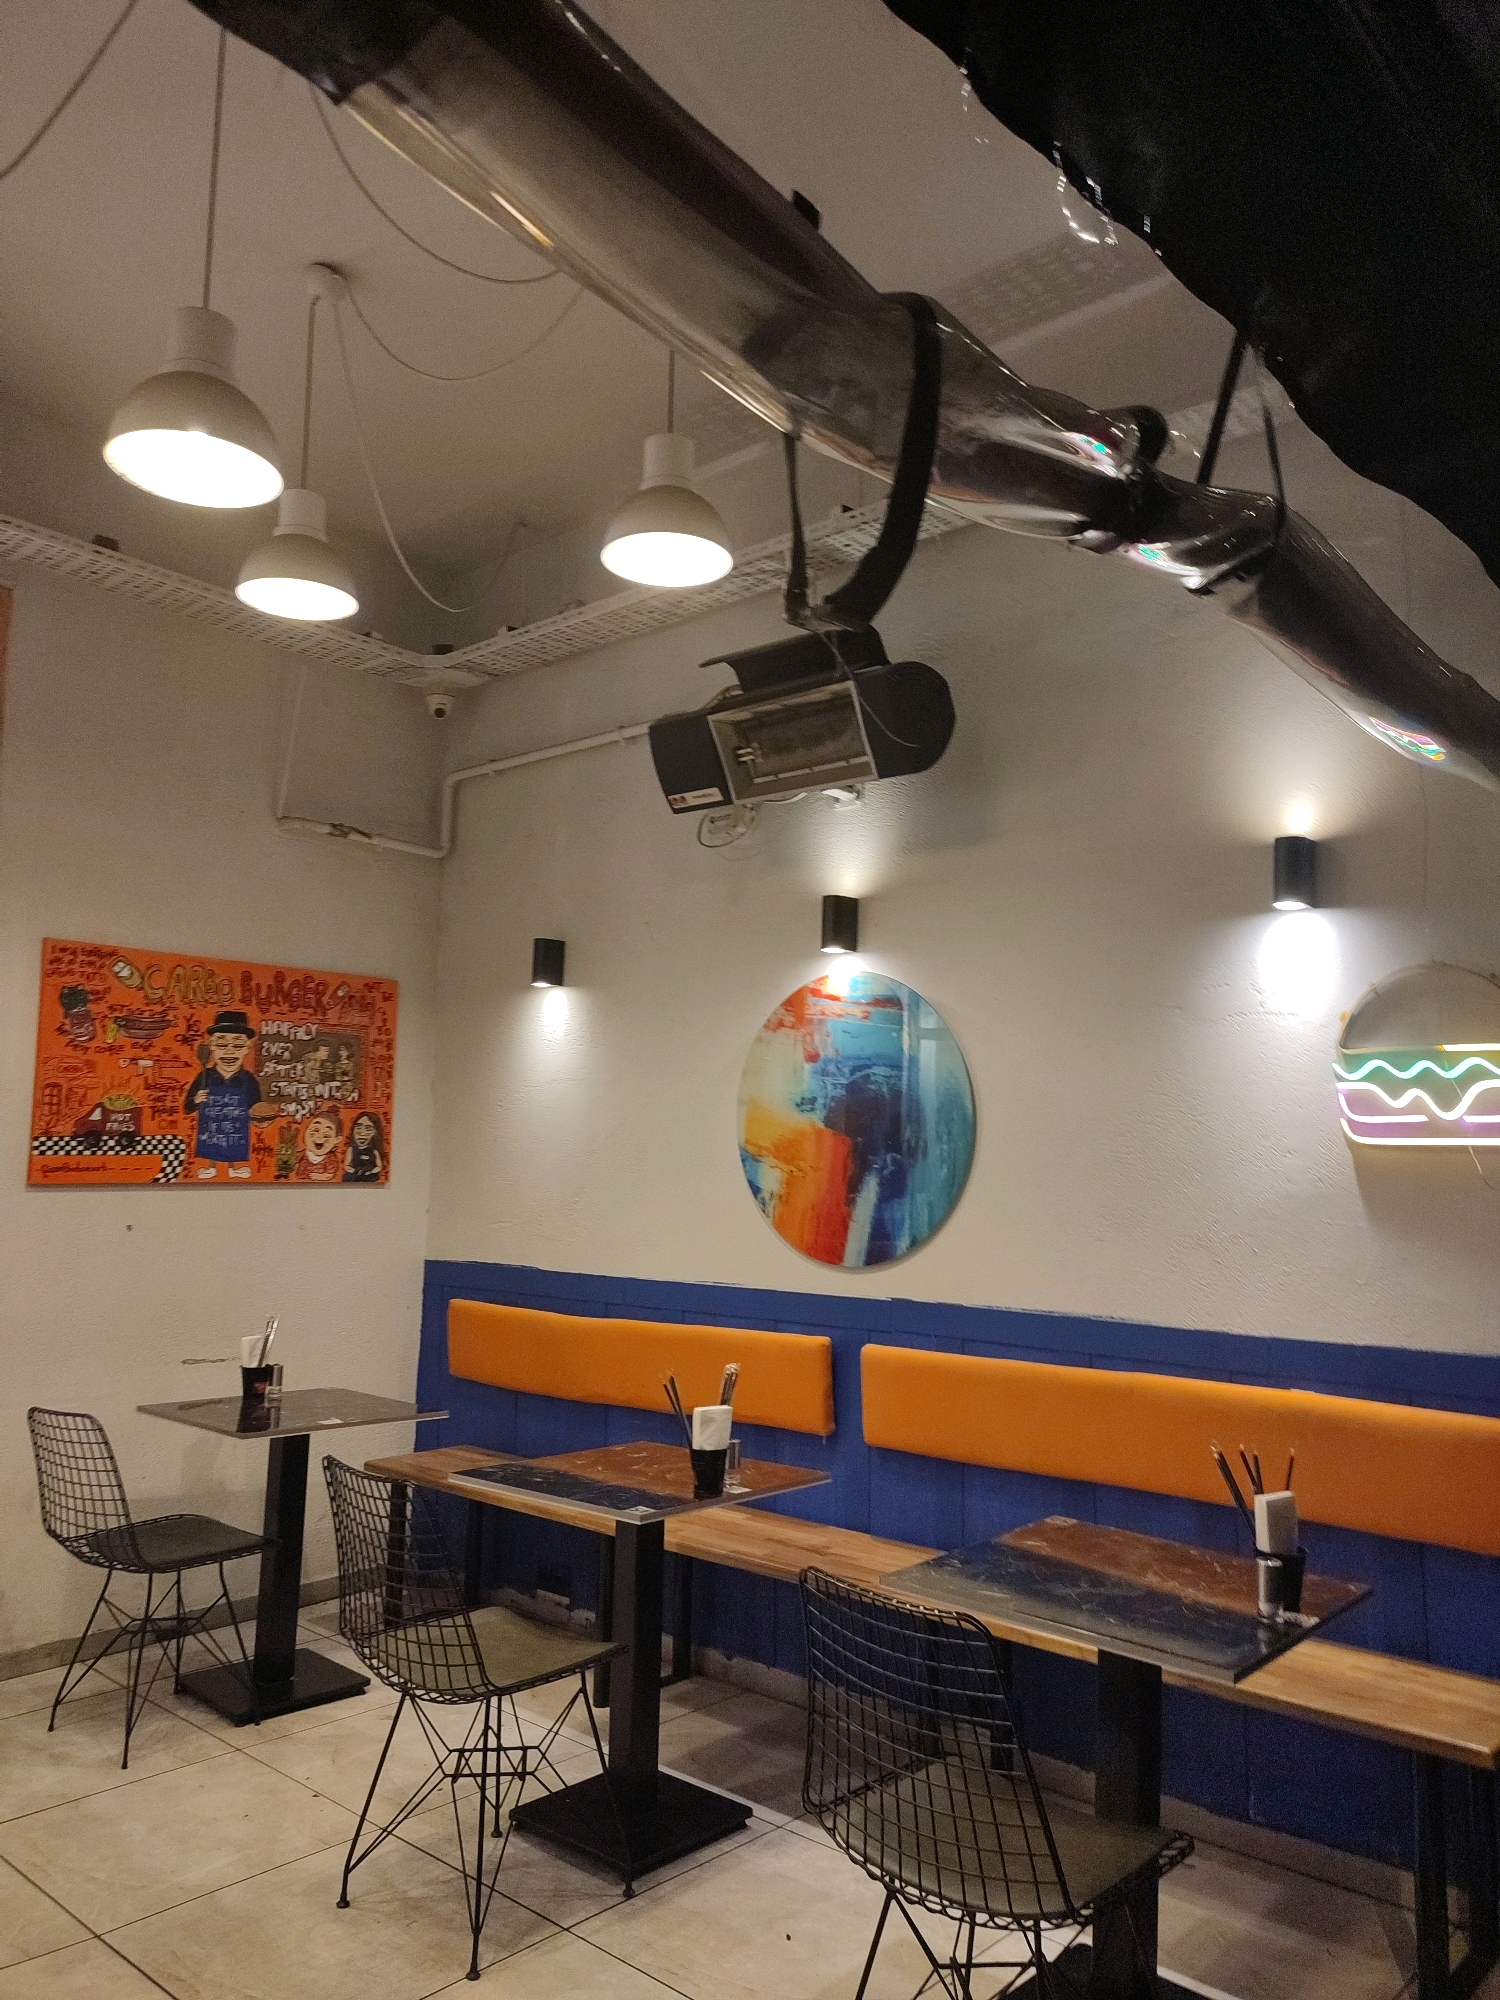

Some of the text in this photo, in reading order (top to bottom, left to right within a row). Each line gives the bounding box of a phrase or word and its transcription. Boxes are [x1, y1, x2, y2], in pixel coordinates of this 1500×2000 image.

[143, 963, 235, 1006] CARBO
[240, 970, 330, 1017] BURGER
[260, 1020, 319, 1040] HAPPILY
[261, 1041, 294, 1060] EVER
[105, 1121, 136, 1132] FRIES
[109, 1113, 133, 1121] HOT
